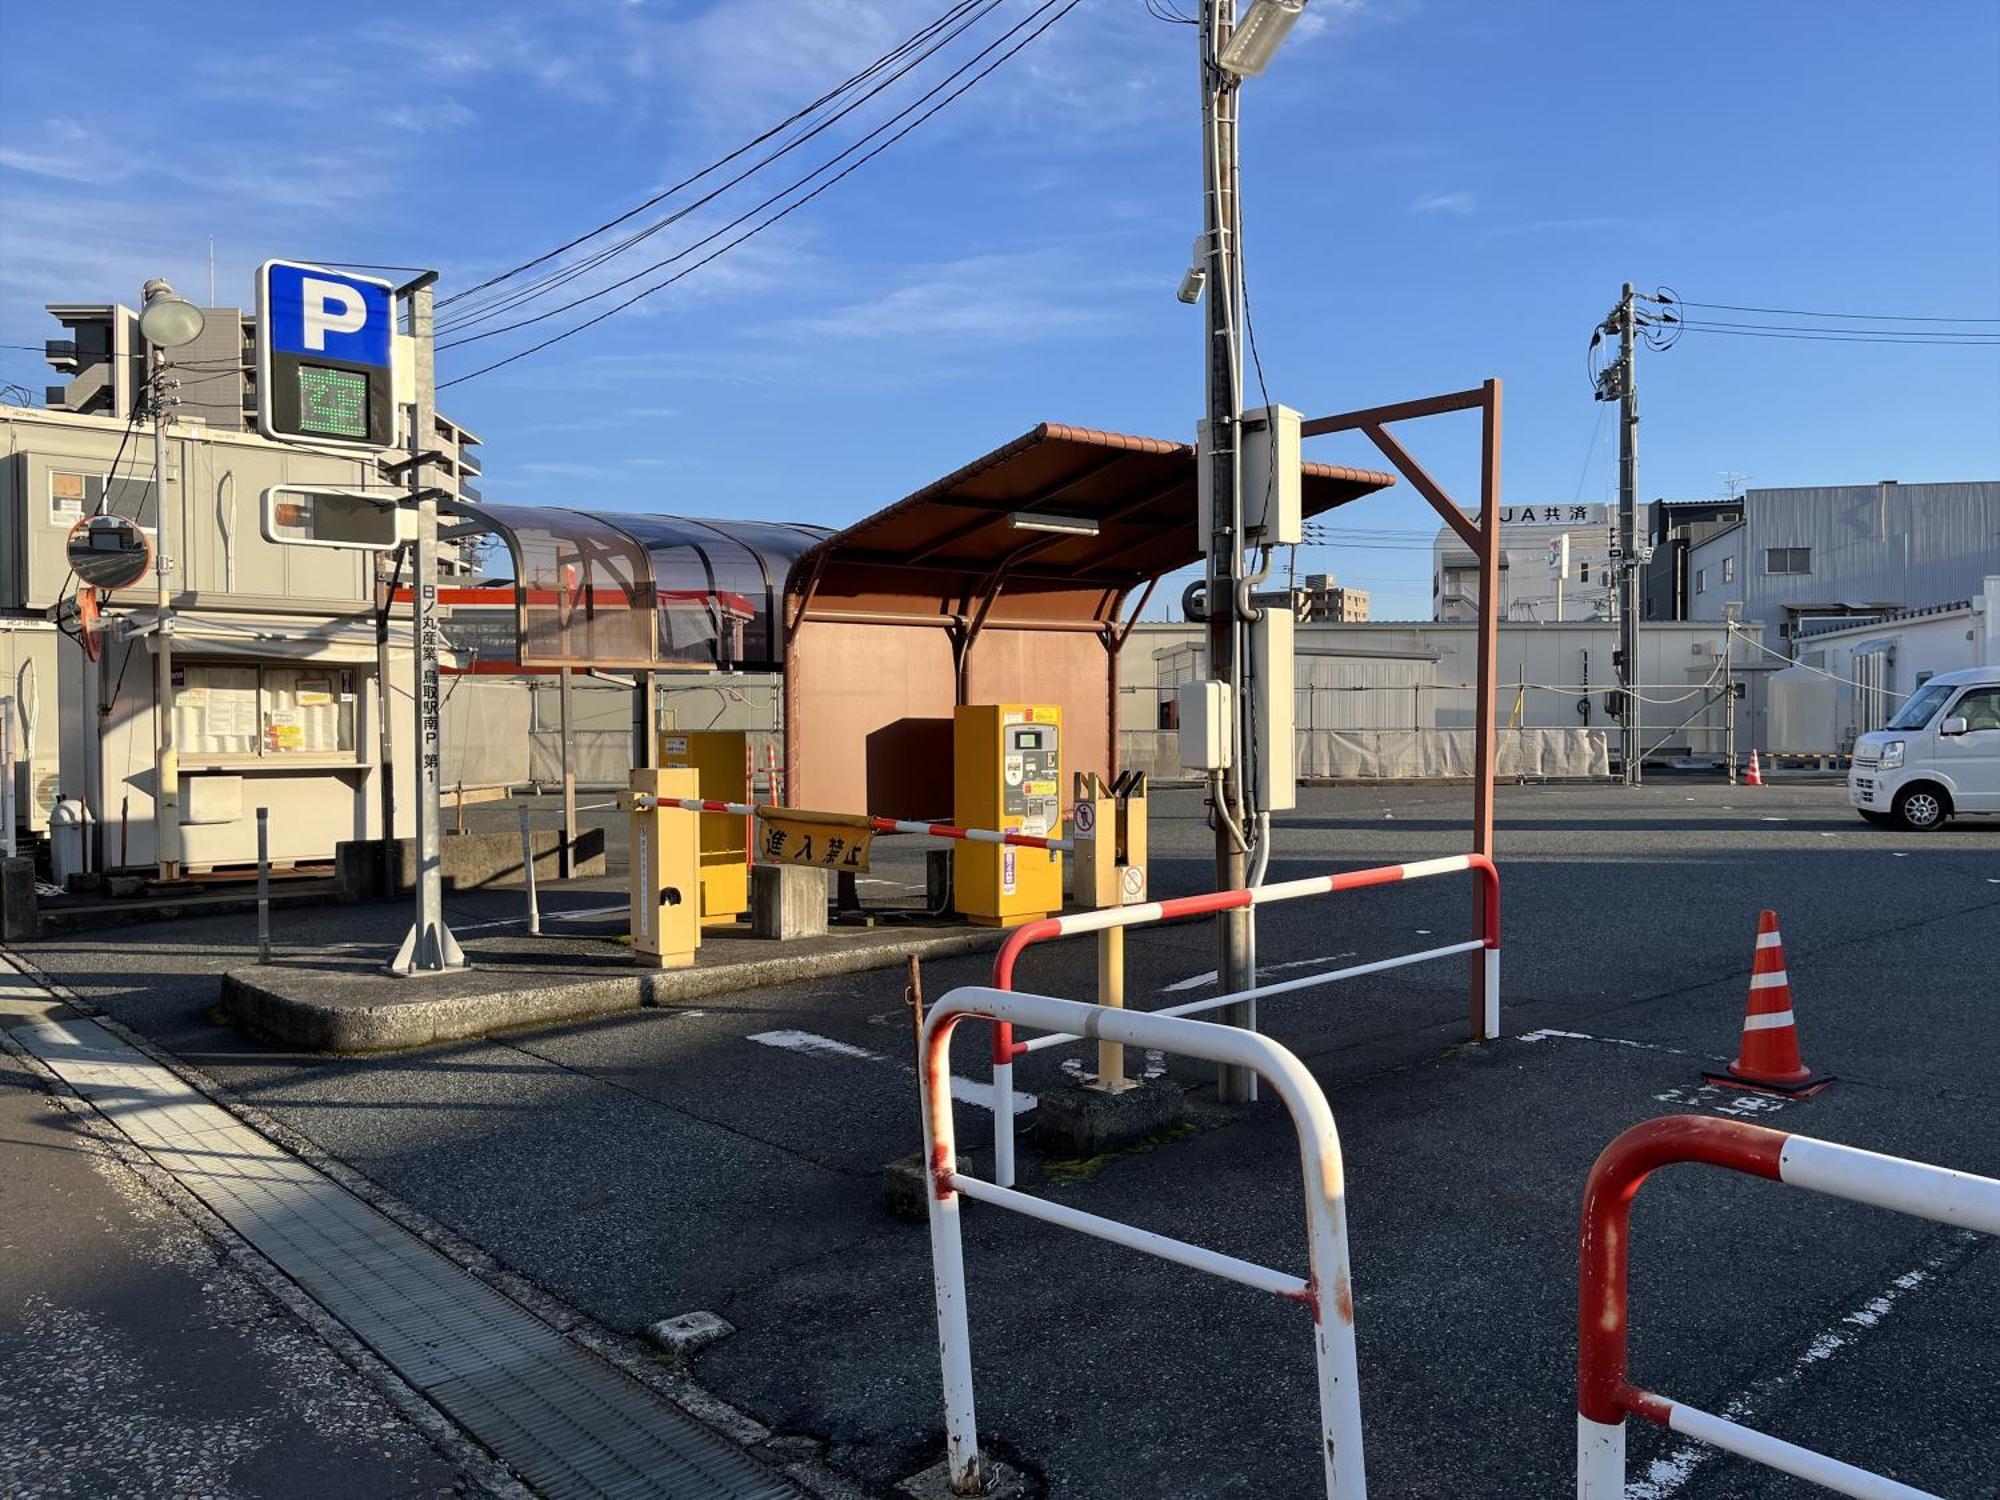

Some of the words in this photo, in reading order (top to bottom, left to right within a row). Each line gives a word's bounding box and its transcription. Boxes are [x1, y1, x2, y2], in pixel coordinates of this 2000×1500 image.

[303, 277, 367, 350] P
[299, 368, 367, 437] 空
[423, 584, 437, 661] 日ノ丸産業
[423, 669, 439, 744] 鳥取駅南P
[424, 753, 439, 783] 第1
[766, 828, 862, 866] 進入禁止
